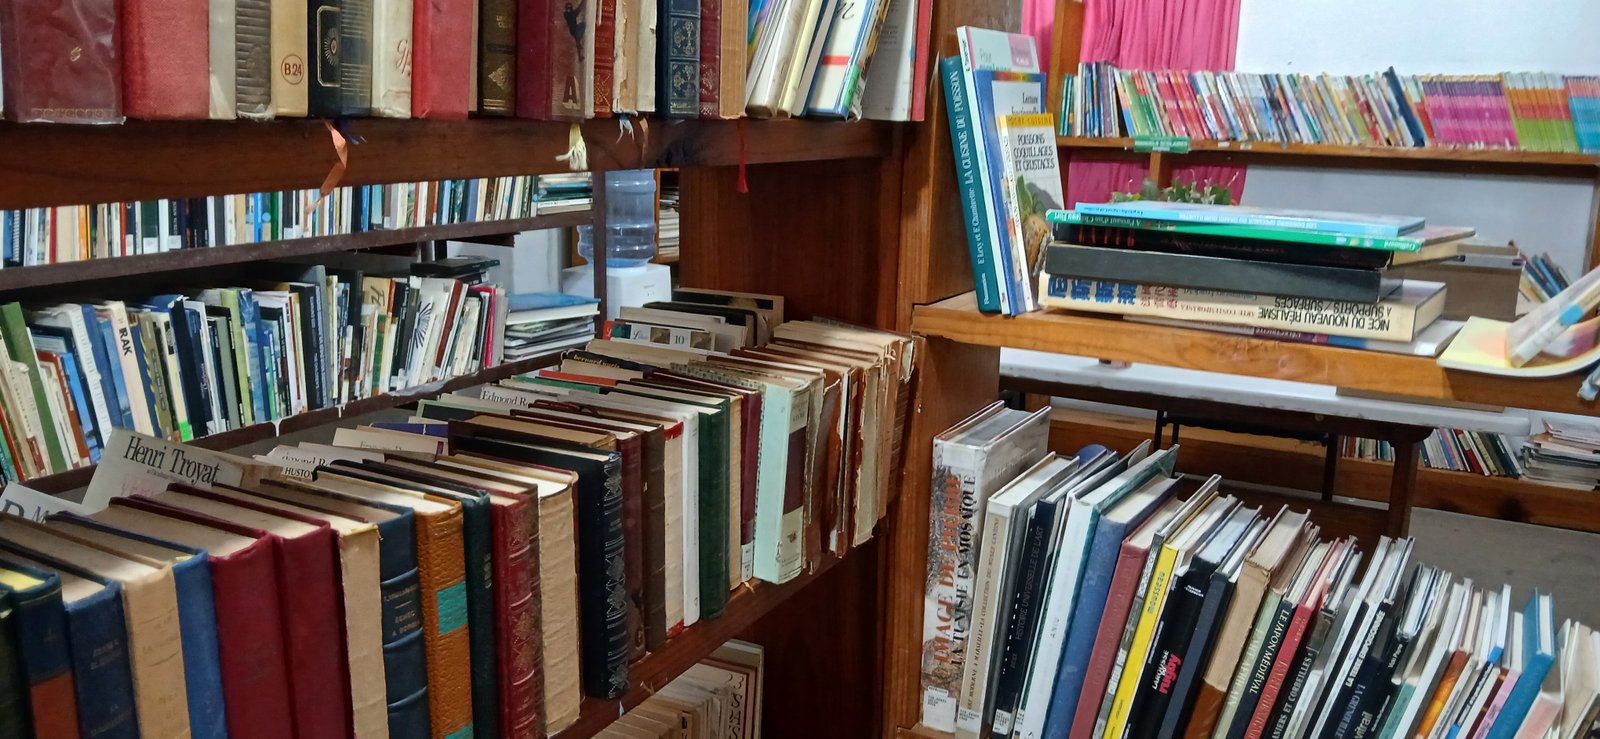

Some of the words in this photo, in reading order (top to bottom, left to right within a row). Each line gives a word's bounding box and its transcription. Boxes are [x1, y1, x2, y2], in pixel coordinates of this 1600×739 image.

[949, 70, 964, 112] POISSON
[957, 131, 972, 169] CUISINE
[1013, 145, 1054, 159] COQUILLAGES
[1258, 306, 1302, 325] RÉALISME
[1274, 296, 1324, 311] SURFACES
[1334, 303, 1384, 318] SUPPORTS
[1305, 312, 1348, 328] NOUVEAU
[1351, 318, 1365, 330] DU
[1367, 319, 1390, 332] NICE
[118, 326, 133, 356] IRAK
[675, 335, 685, 344] 10
[482, 391, 517, 405] Edmond
[123, 436, 167, 469] Henri
[168, 448, 221, 485] Troyat
[957, 475, 978, 554] MOSAÏQUE
[1032, 525, 1044, 544] L'ART
[1030, 544, 1040, 558] DE
[957, 555, 971, 579] EN
[1020, 558, 1038, 607] UNIVERSELLE
[933, 593, 953, 661] IMAGE
[952, 583, 969, 643] TUNISIE
[972, 627, 984, 661] MARSEILLE
[979, 580, 991, 616] COLLECTION
[1013, 607, 1028, 641] HISTOIRE
[1277, 608, 1290, 622] LE
[1265, 620, 1285, 651] JAPON
[1151, 650, 1170, 690] LAROUSSE
[1159, 653, 1183, 695] rugby
[1248, 649, 1275, 696] MÉDIÉVAL
[1286, 655, 1312, 703] CORBEILLES
[1281, 701, 1293, 713] ET
[1351, 709, 1373, 739] vitrail
